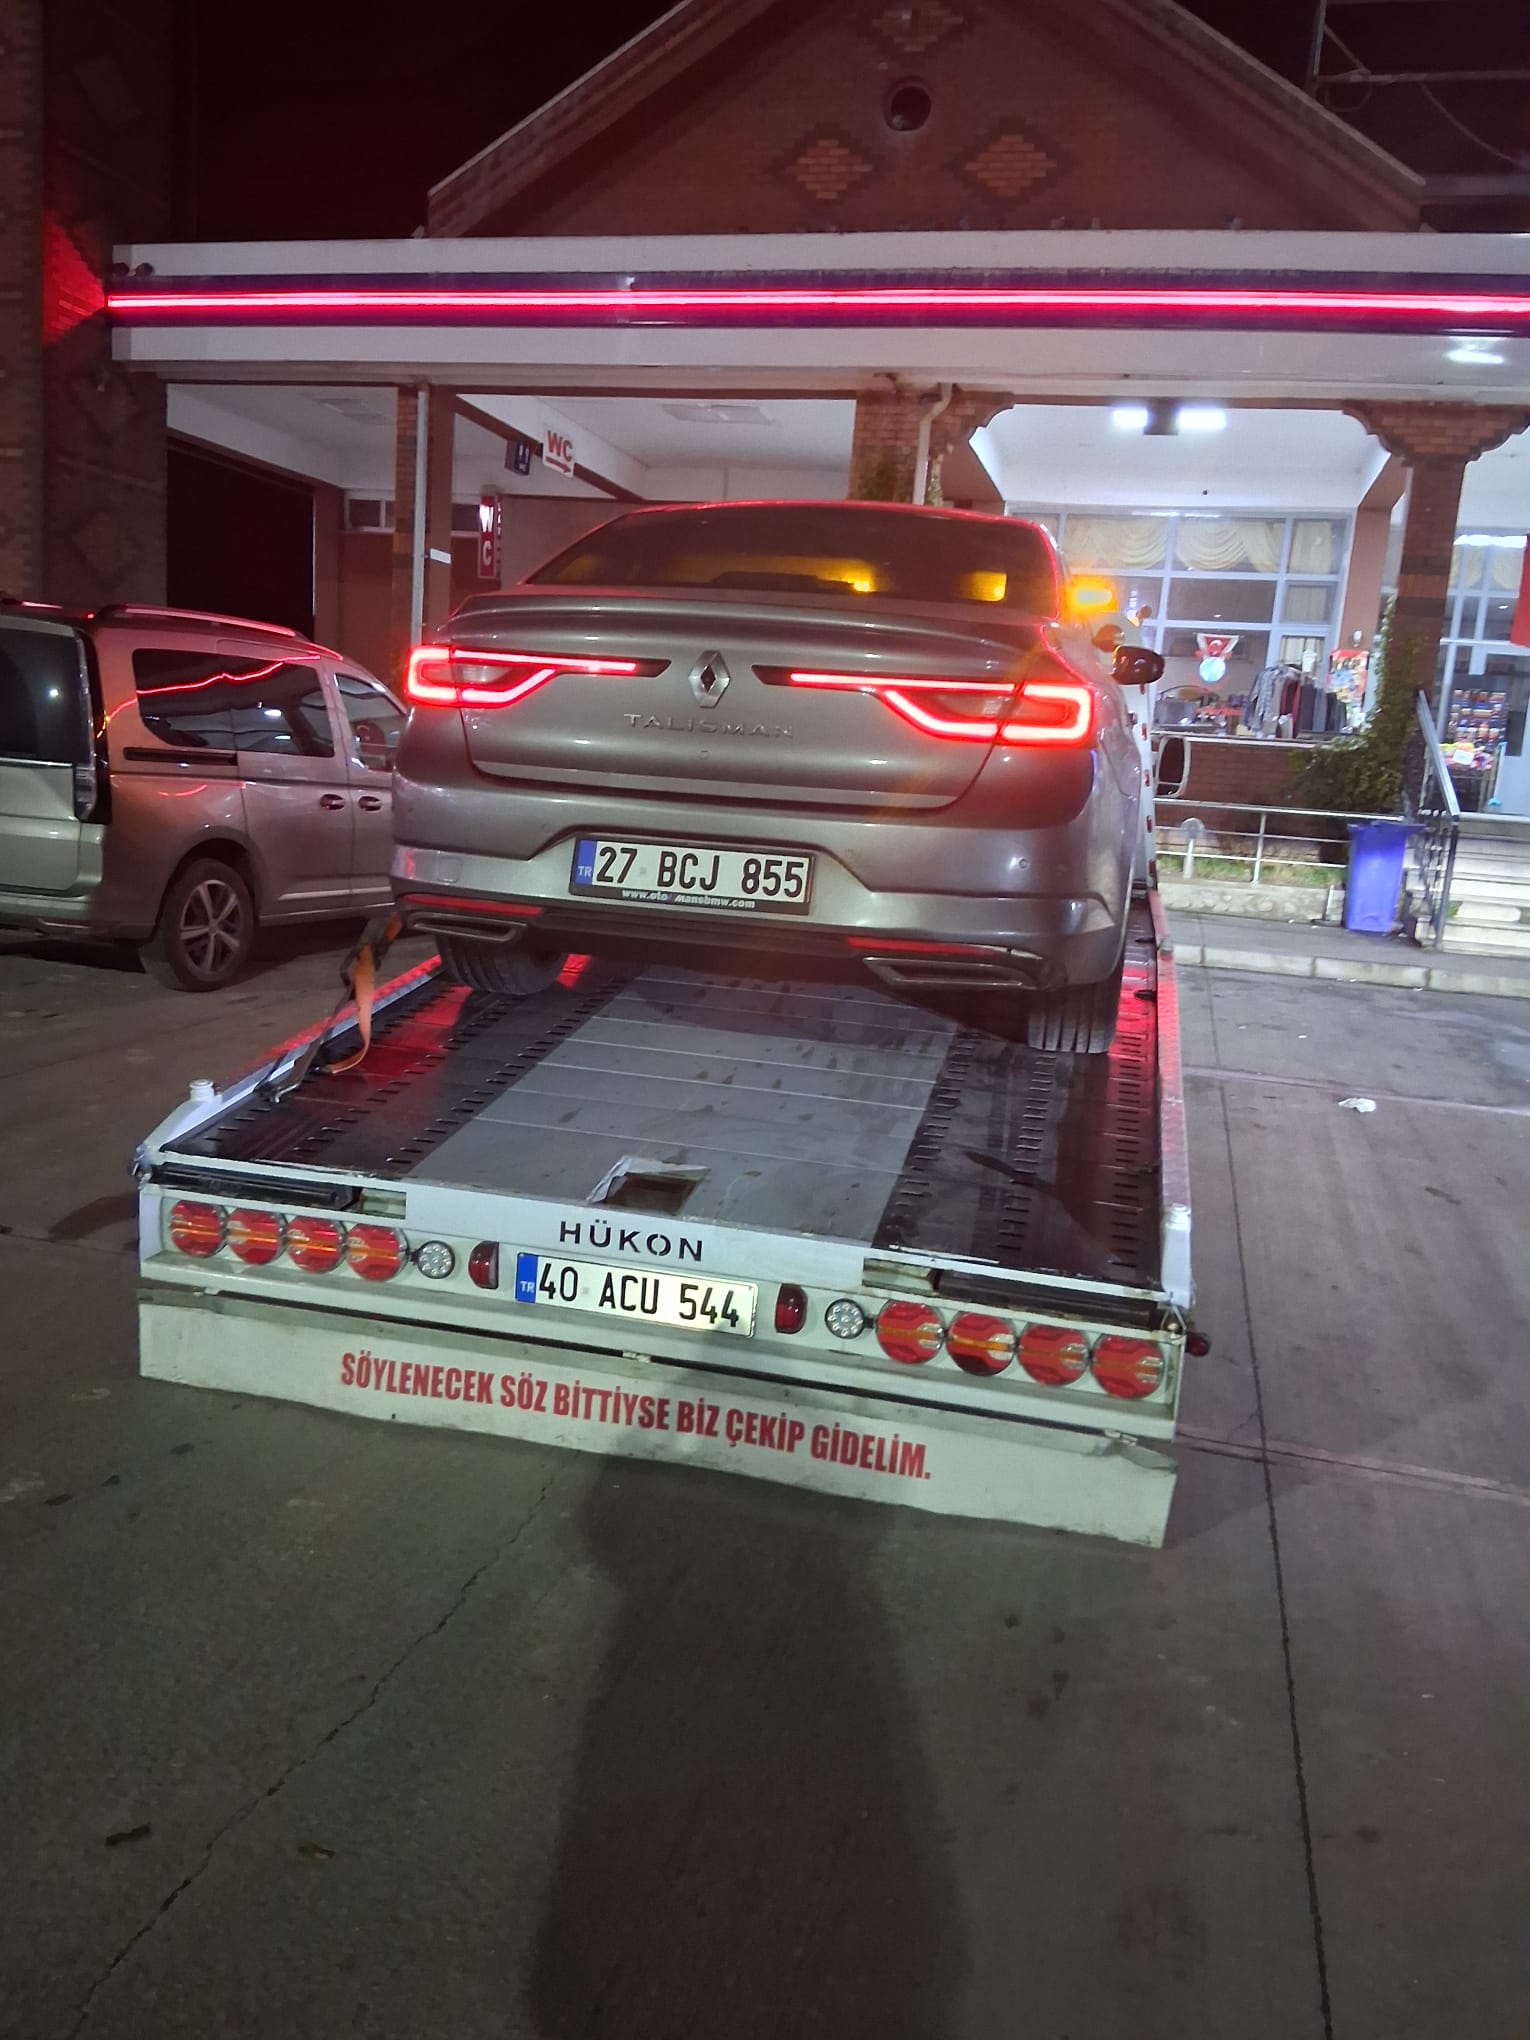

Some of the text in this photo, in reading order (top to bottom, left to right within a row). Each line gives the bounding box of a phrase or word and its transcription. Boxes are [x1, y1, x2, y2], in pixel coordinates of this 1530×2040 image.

[546, 429, 573, 462] WC
[479, 503, 494, 567] WC
[623, 713, 793, 739] TALISMAN
[577, 865, 592, 877] TR
[596, 846, 804, 899] 27 BCJ 855
[559, 1219, 703, 1262] HÜKON
[520, 1280, 535, 1293] TR
[538, 1262, 739, 1328] 40 ACU 544
[340, 1350, 931, 1480] SÖYLENECEK SÖZ BİTTİYSE BİZ ÇEKİP GİDELİM.
